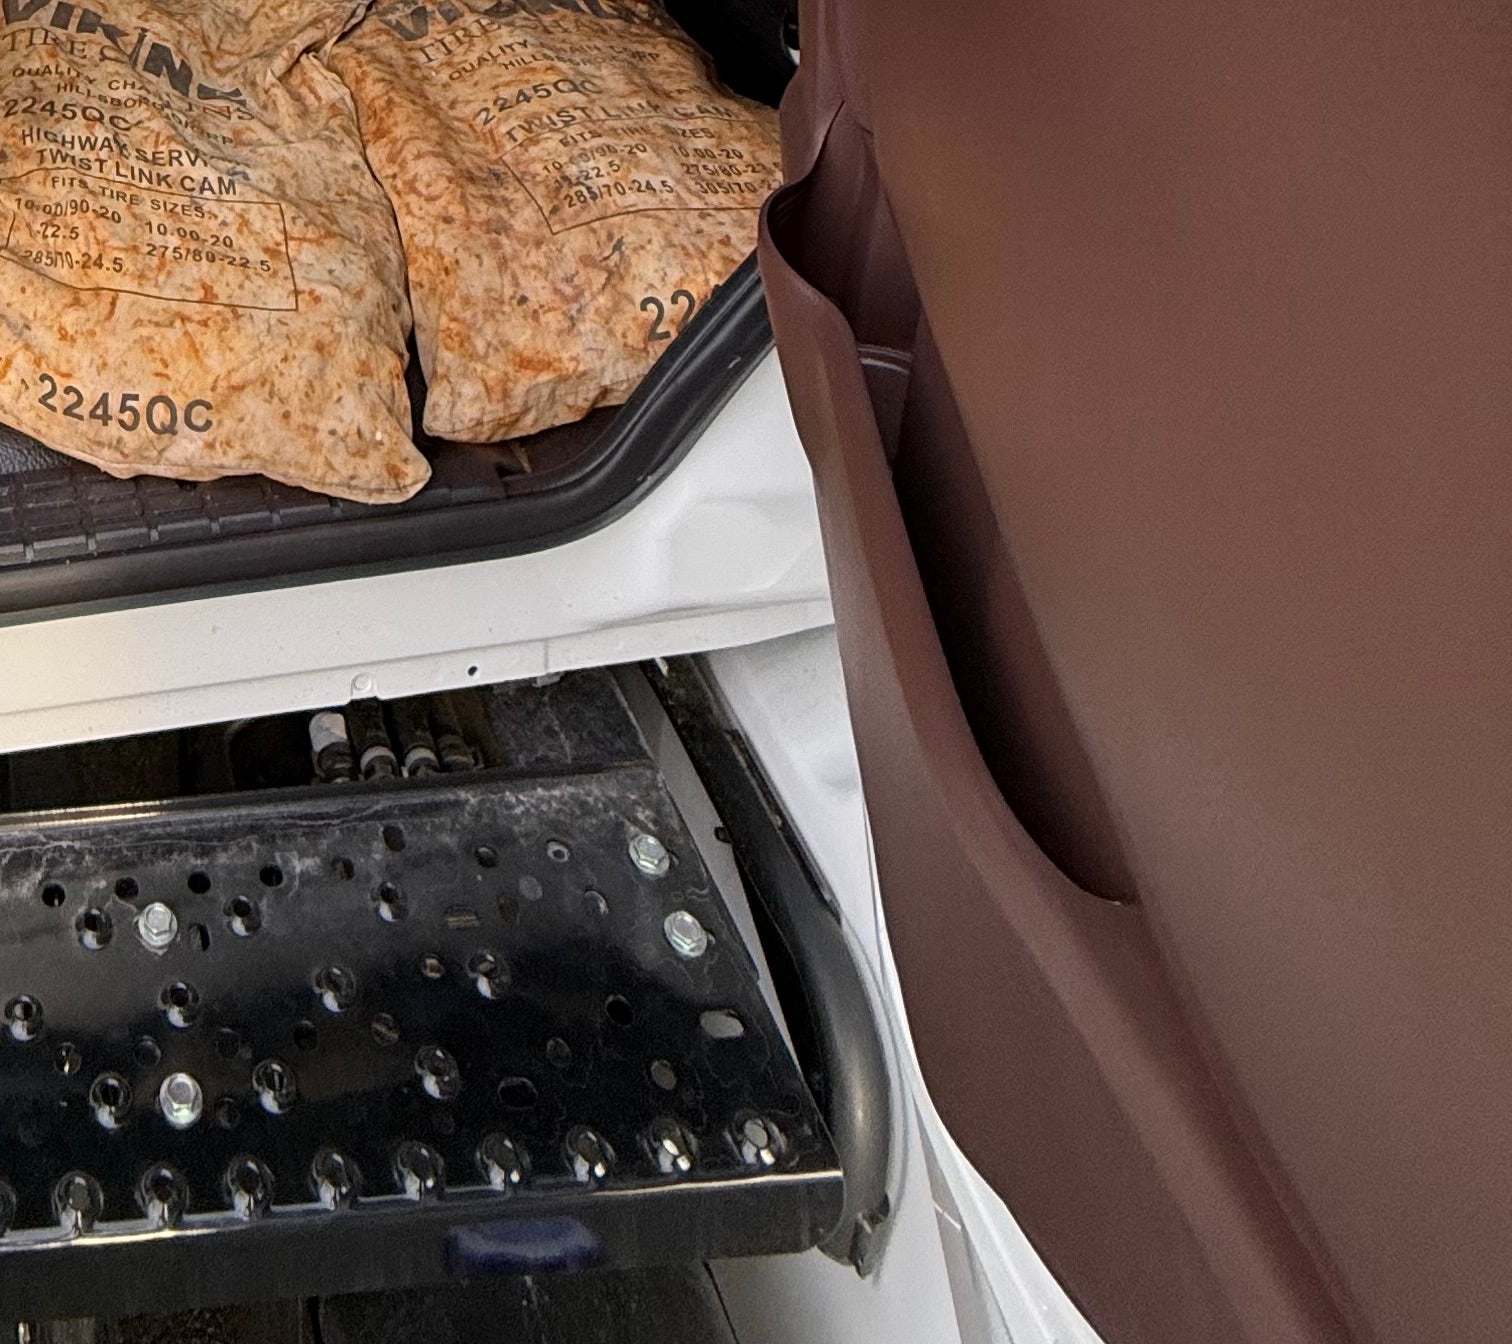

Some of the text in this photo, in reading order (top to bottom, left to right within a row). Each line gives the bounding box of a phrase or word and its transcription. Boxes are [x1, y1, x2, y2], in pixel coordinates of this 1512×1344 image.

[448, 38, 530, 81] QUALITY
[3, 96, 136, 132] 2245QC
[504, 105, 594, 144] TWIST
[36, 148, 237, 196] TWIST LINK CAM
[51, 176, 206, 219] FITS TIRE SIZES
[144, 220, 234, 249] 10.00-20
[38, 372, 214, 436] 2245QC
